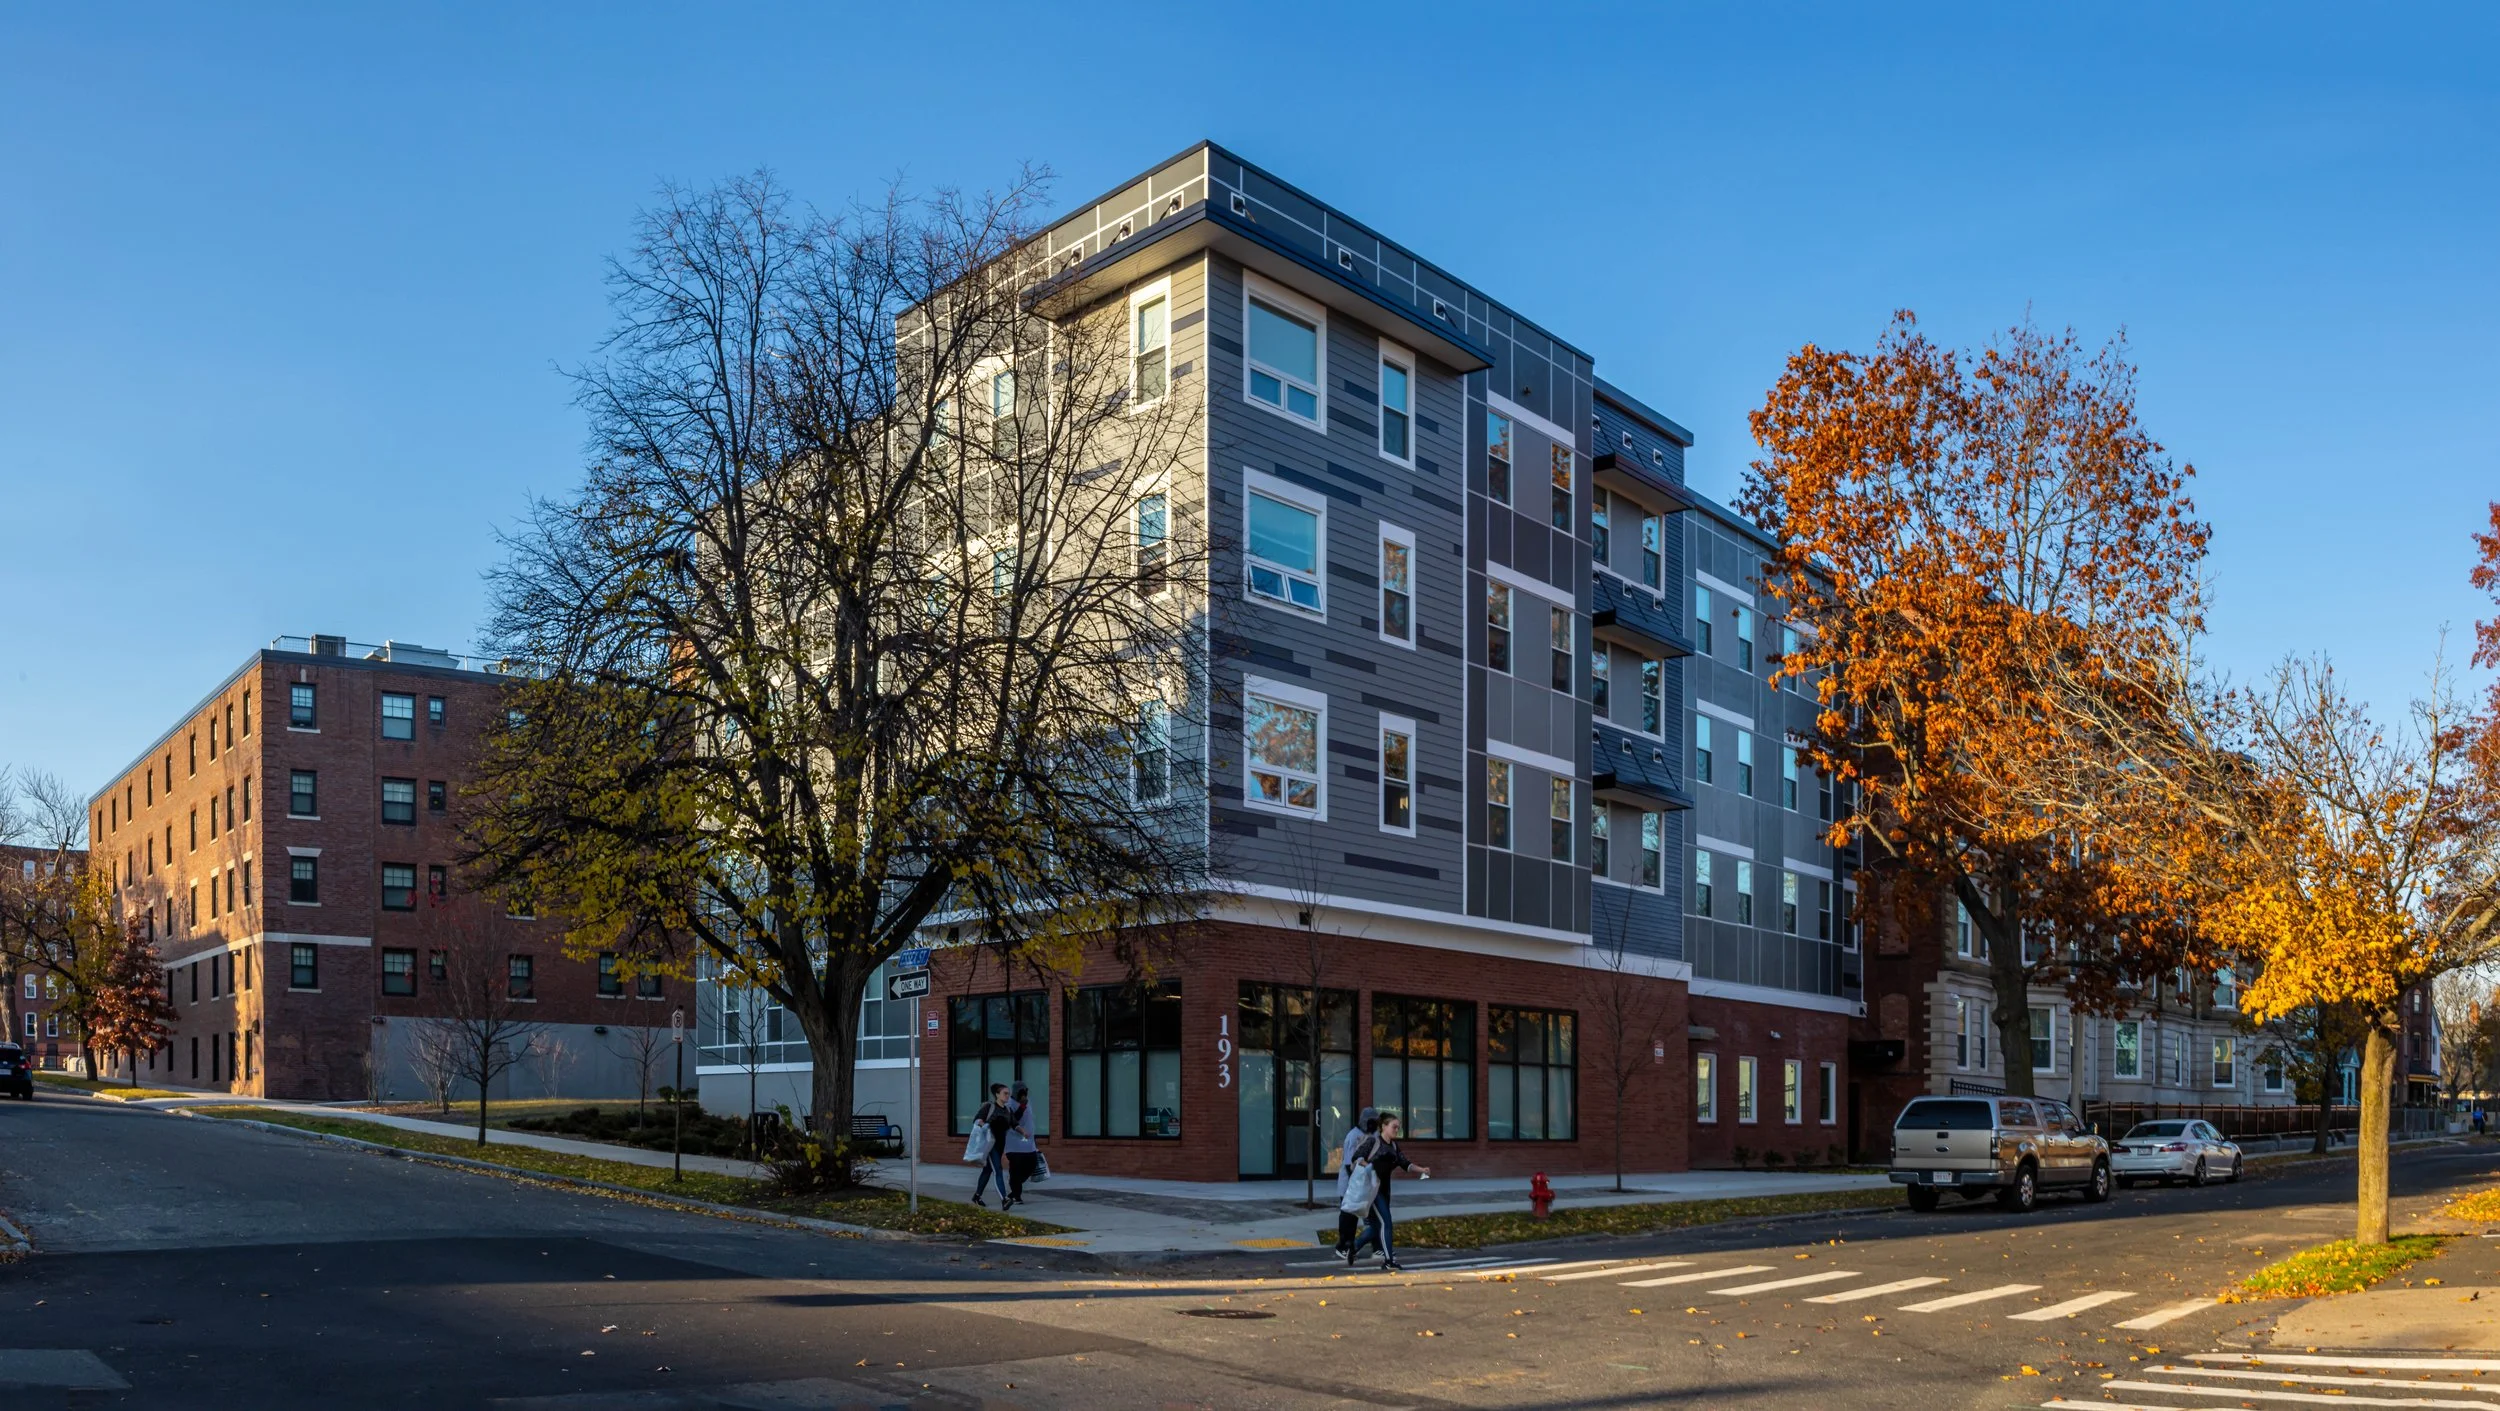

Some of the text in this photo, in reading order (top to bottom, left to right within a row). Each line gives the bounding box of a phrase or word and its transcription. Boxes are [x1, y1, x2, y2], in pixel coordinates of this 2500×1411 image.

[901, 978, 925, 991] ONE WAY
[1217, 1014, 1232, 1088] 193
